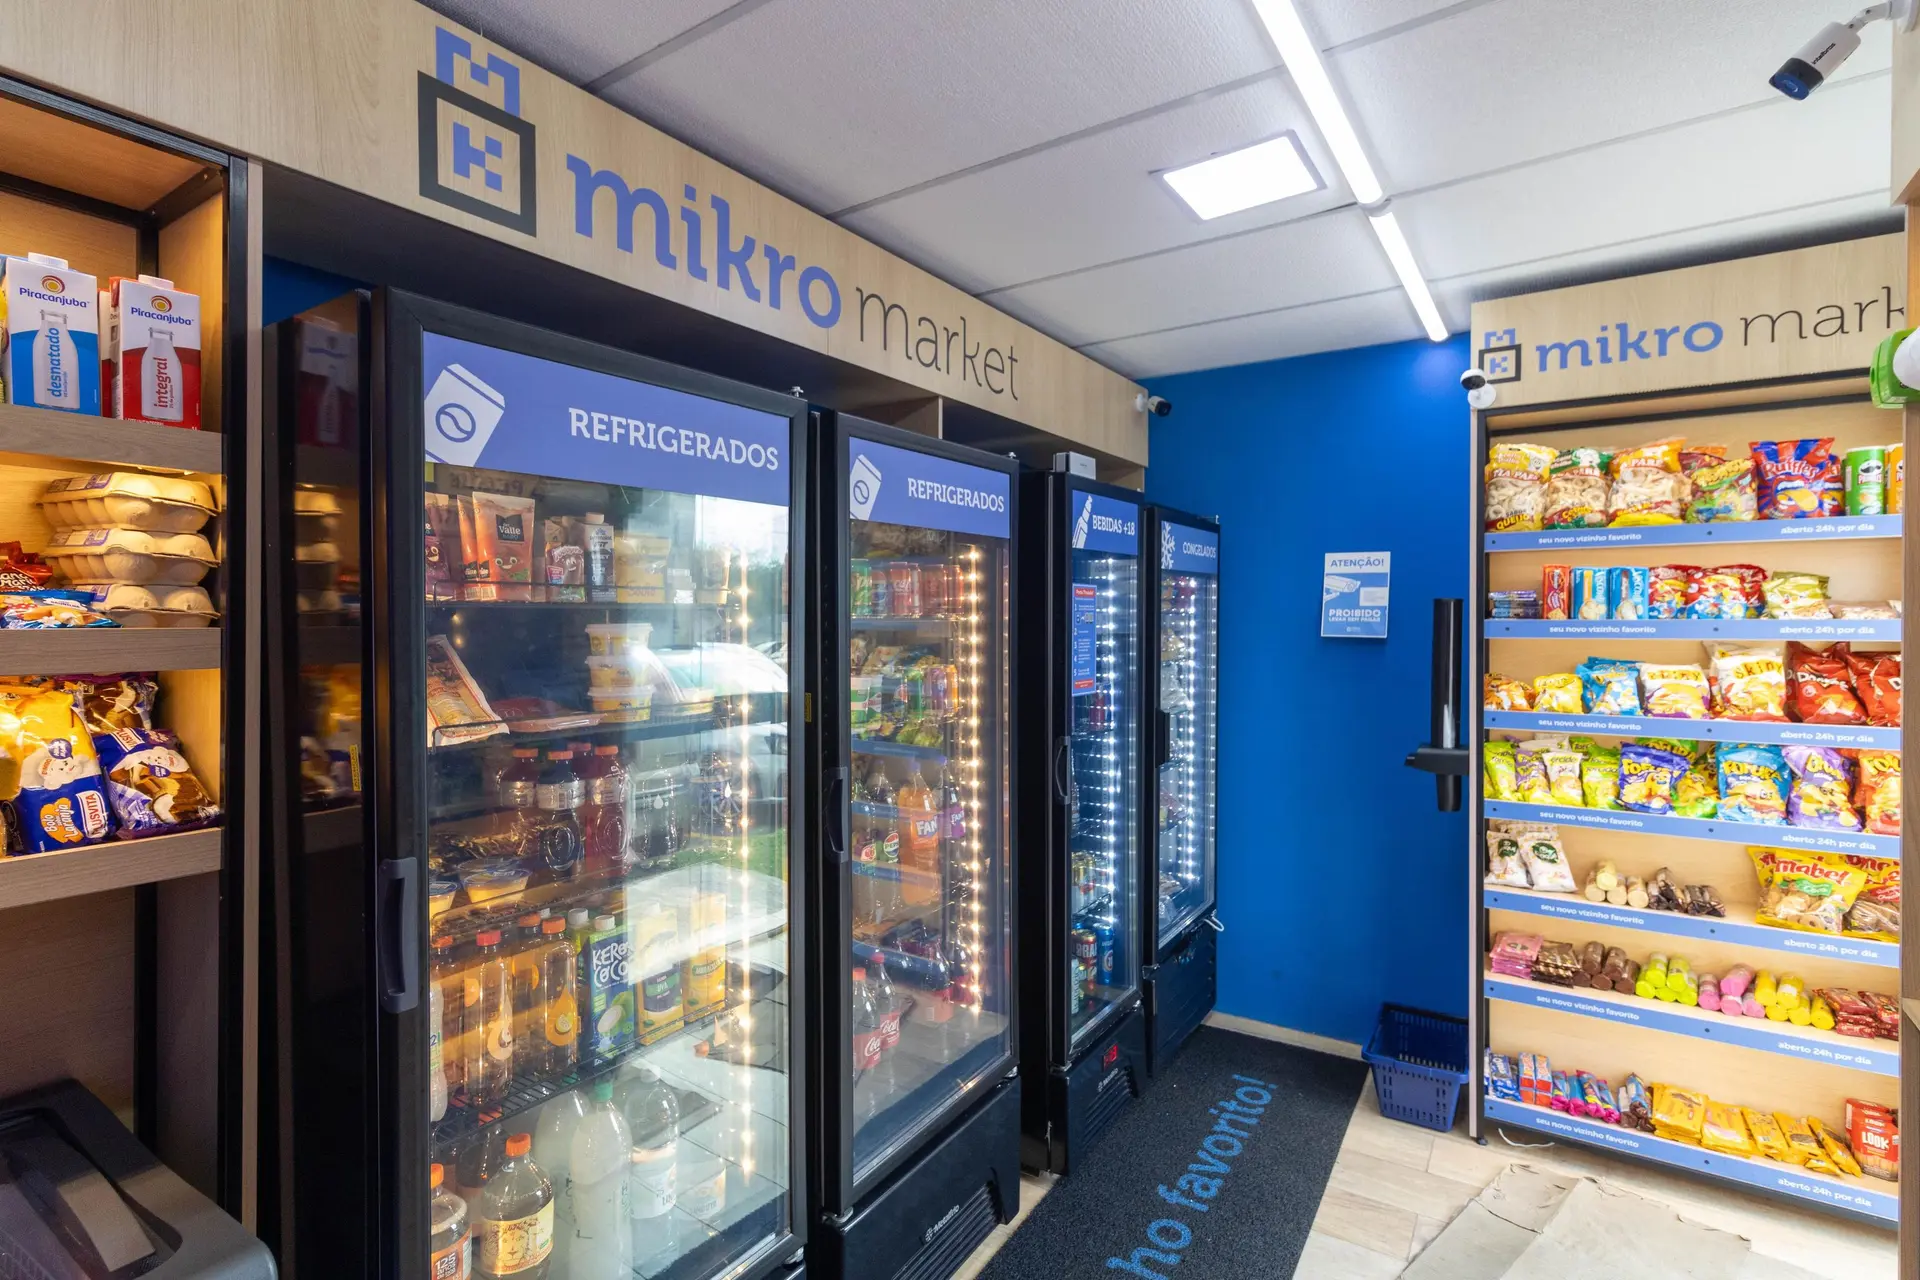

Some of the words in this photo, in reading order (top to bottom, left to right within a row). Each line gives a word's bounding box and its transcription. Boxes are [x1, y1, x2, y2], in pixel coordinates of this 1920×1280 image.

[566, 154, 841, 329] mikro
[855, 286, 1018, 402] market
[19, 287, 87, 309] Piracanjuba
[131, 307, 192, 326] Piracanjuba
[1536, 321, 1724, 372] mikro
[47, 328, 61, 398] desnatado
[153, 357, 172, 409] integral
[568, 406, 779, 471] REFRIGERADOS
[1763, 457, 1820, 480] Ruffles
[907, 477, 1005, 513] REFRIGERADOS
[499, 525, 521, 535] Valle
[1092, 514, 1122, 535] BEBIDAS
[1123, 521, 1135, 536] +18
[1496, 514, 1530, 530] QUEIJO
[1781, 526, 1813, 534] aberto
[1837, 525, 1856, 533] por
[1858, 523, 1875, 531] dia
[1576, 534, 1607, 542] vizinho
[1608, 533, 1641, 541] favorito
[1182, 541, 1216, 558] CONGELADOS
[1330, 556, 1384, 569] ATENÇÃO!
[1329, 608, 1381, 617] PROIBIDO
[1837, 627, 1855, 635] por
[1576, 721, 1606, 729] vizinho
[1608, 722, 1641, 731] favorito
[1780, 731, 1813, 740] aberto
[1837, 734, 1855, 743] por
[1857, 735, 1874, 743] dia
[44, 814, 55, 833] Bolo
[58, 804, 78, 839] Laranja
[1555, 813, 1576, 821] novo
[1577, 814, 1608, 824] vizinho
[1609, 817, 1643, 827] favorito
[1782, 835, 1815, 844] aberto
[1817, 838, 1836, 846] 24h
[1839, 841, 1857, 849] por
[1859, 842, 1876, 850] dia
[1556, 907, 1577, 915] novo
[1579, 908, 1609, 920] vizinho
[1611, 914, 1644, 925] favorito
[1784, 939, 1817, 950] aberto
[1819, 943, 1838, 952] 24h
[1840, 946, 1859, 956] por
[1861, 949, 1878, 958] dia
[1536, 995, 1550, 1003] seu
[1552, 999, 1572, 1008] novo
[1574, 1001, 1604, 1014] vizinho
[1606, 1008, 1639, 1021] favorito
[1778, 1041, 1811, 1054] aberto
[1813, 1047, 1833, 1058] 24h
[1835, 1051, 1853, 1061] por
[1855, 1055, 1872, 1065] dia
[1536, 1117, 1550, 1126] seu
[1552, 1122, 1572, 1131] novo
[1574, 1125, 1604, 1140] vizinho
[1605, 1133, 1639, 1148] favorito
[1862, 1131, 1890, 1149] LOOK
[1157, 1074, 1278, 1212] favorito!
[1778, 1178, 1810, 1191] aberto
[1812, 1186, 1832, 1197] 24h
[1834, 1191, 1853, 1202] por
[1855, 1196, 1872, 1207] dia
[435, 1252, 457, 1270] 125
